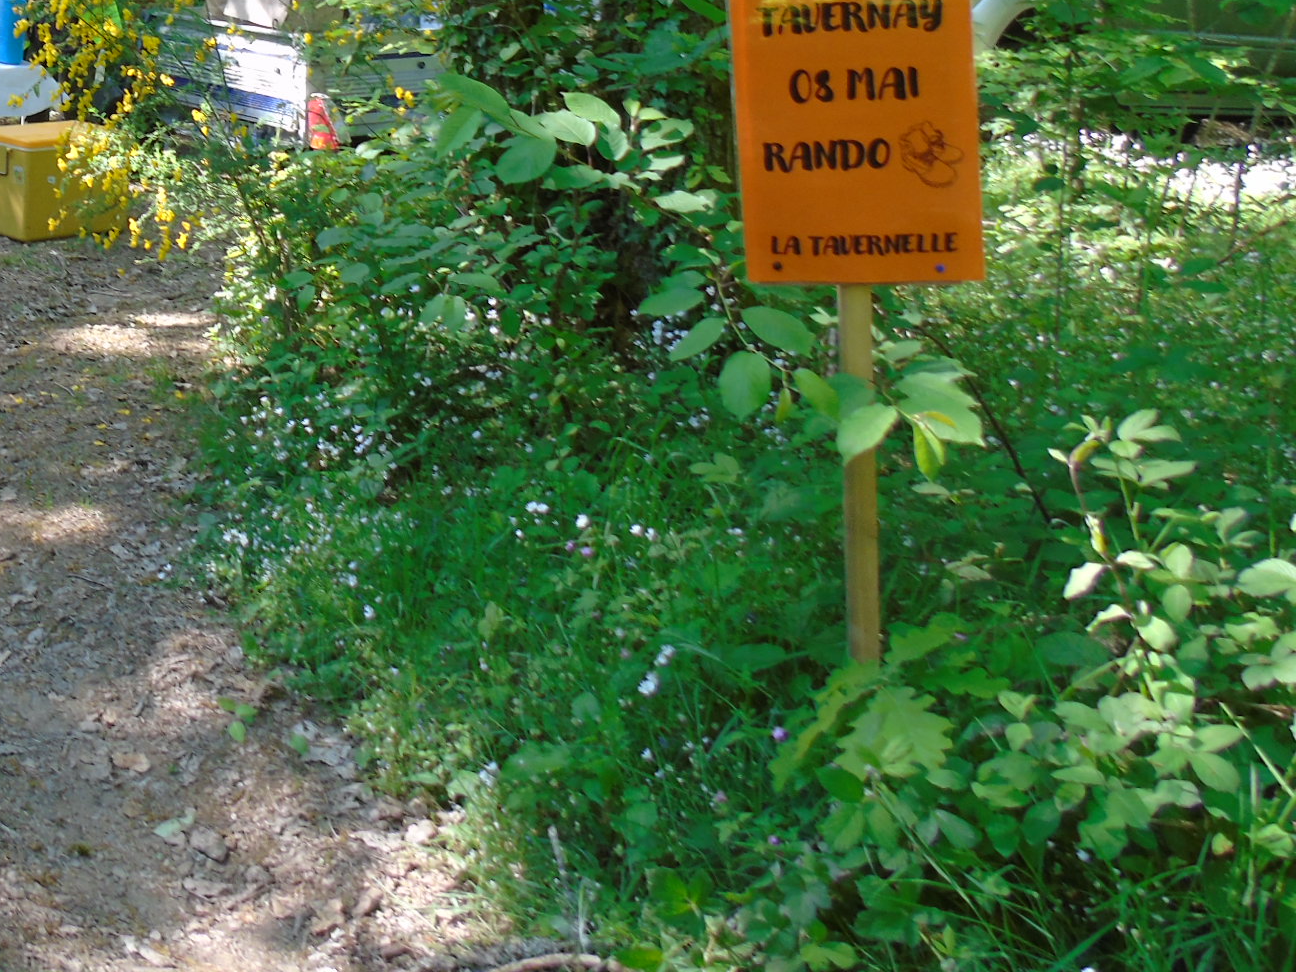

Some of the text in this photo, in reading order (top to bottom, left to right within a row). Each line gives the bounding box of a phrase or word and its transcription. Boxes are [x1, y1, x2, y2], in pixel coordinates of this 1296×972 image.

[789, 66, 919, 104] 08 MAI
[763, 138, 891, 173] RANDO
[771, 232, 958, 256] LA TAVERNELLE
